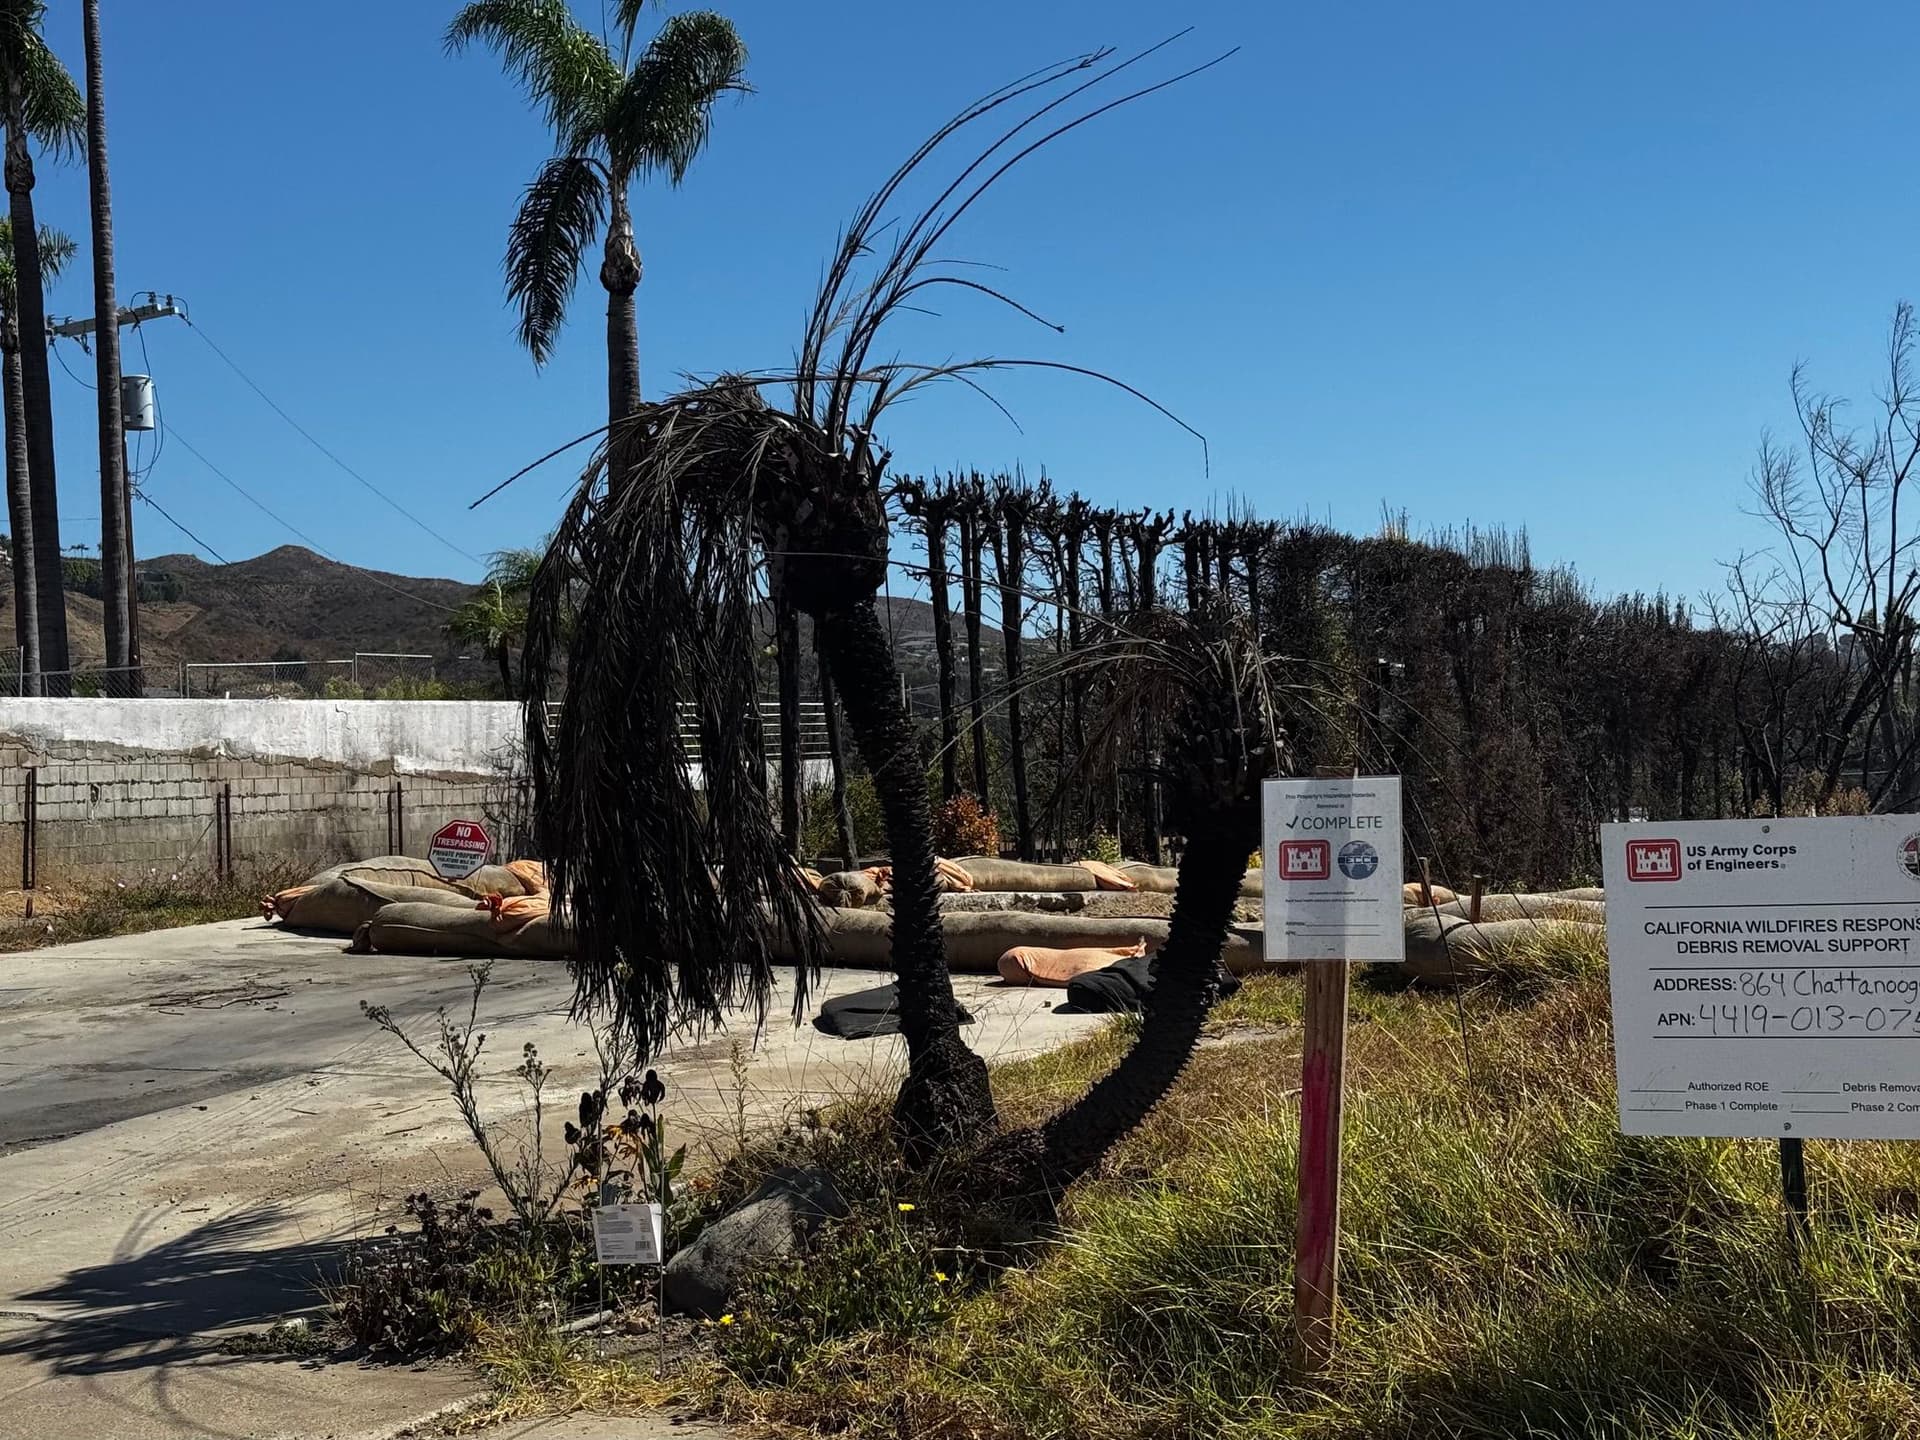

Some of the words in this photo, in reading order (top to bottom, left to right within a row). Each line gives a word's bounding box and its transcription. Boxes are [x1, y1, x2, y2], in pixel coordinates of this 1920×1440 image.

[1301, 815, 1383, 830] COMPLETE
[456, 826, 472, 838] NO
[437, 837, 486, 850] TRESPASSING
[1686, 846, 1706, 857] US
[1711, 845, 1748, 859] Army
[1753, 844, 1797, 857] Corps
[1687, 860, 1702, 870] of
[1705, 859, 1779, 873] Engineers
[1644, 920, 1743, 935] CALIFORNIA
[1745, 919, 1838, 934] WILDFIRES
[1677, 940, 1738, 954] DEBRIS
[1742, 939, 1824, 953] REMOVAL
[1827, 937, 1911, 952] SUPPORT
[1653, 978, 1737, 991] ADDRESS:
[1740, 972, 1786, 997] 864
[1793, 970, 1920, 1004] Chattanoog
[1657, 1012, 1696, 1026] APN:
[1687, 1082, 1741, 1091] Authorized
[1745, 1082, 1769, 1091] ROE
[1843, 1083, 1876, 1092] Debris
[1685, 1101, 1717, 1110] Phase
[1729, 1101, 1778, 1112] Complete
[1851, 1103, 1885, 1112] Phase
[1887, 1103, 1894, 1112] 2
